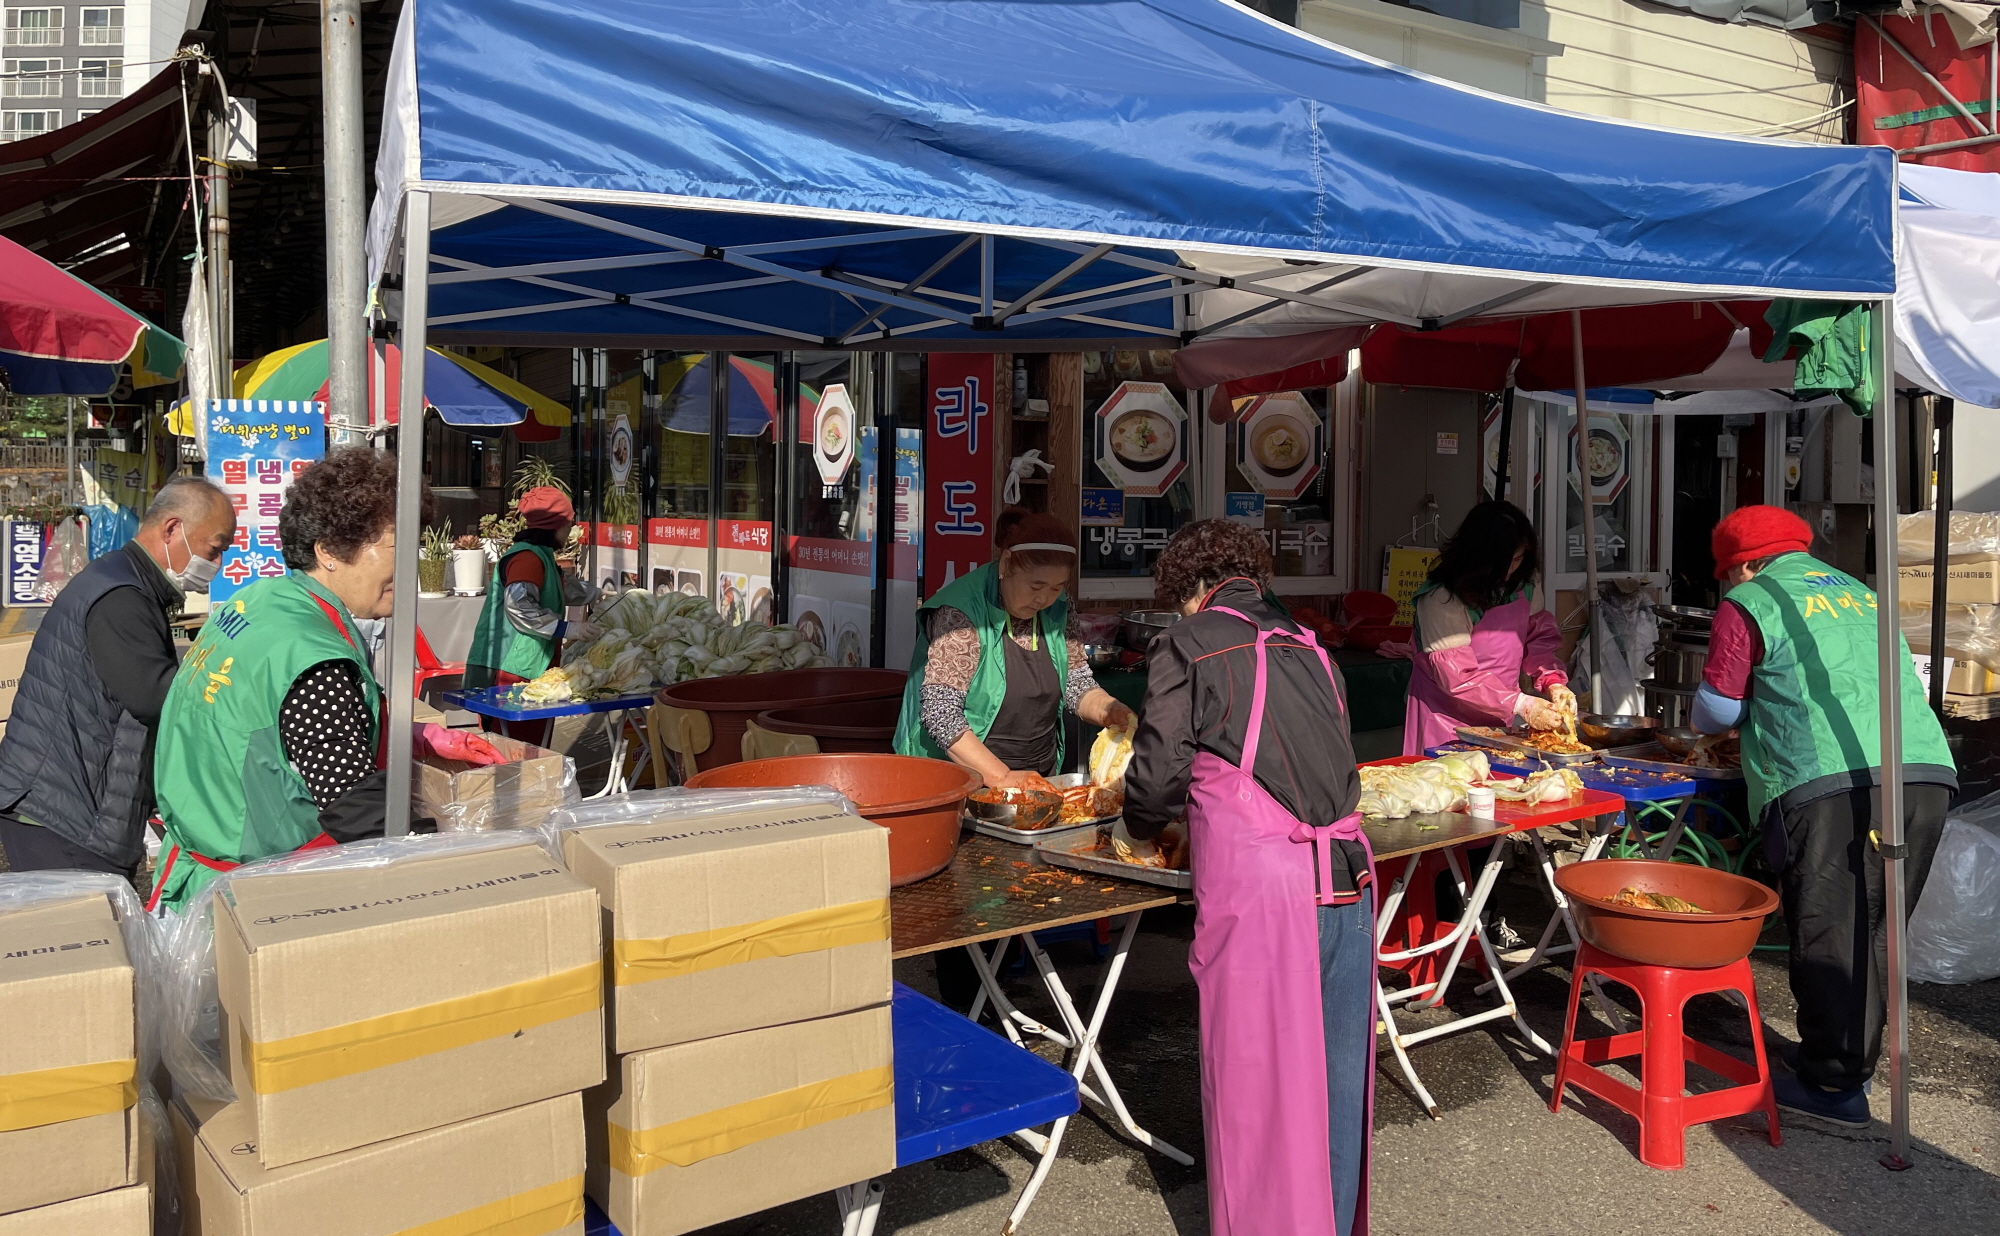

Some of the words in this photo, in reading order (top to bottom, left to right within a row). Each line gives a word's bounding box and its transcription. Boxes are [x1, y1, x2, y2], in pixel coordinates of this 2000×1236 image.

[221, 422, 279, 439] 더위사냥
[283, 424, 310, 441] 별미
[1235, 500, 1255, 510] 가맹점
[1090, 526, 1173, 556] 냉콩국
[813, 547, 830, 562] 전통의
[832, 548, 849, 565] 어머니
[1802, 574, 1853, 589] SMU
[213, 603, 251, 641] SMU
